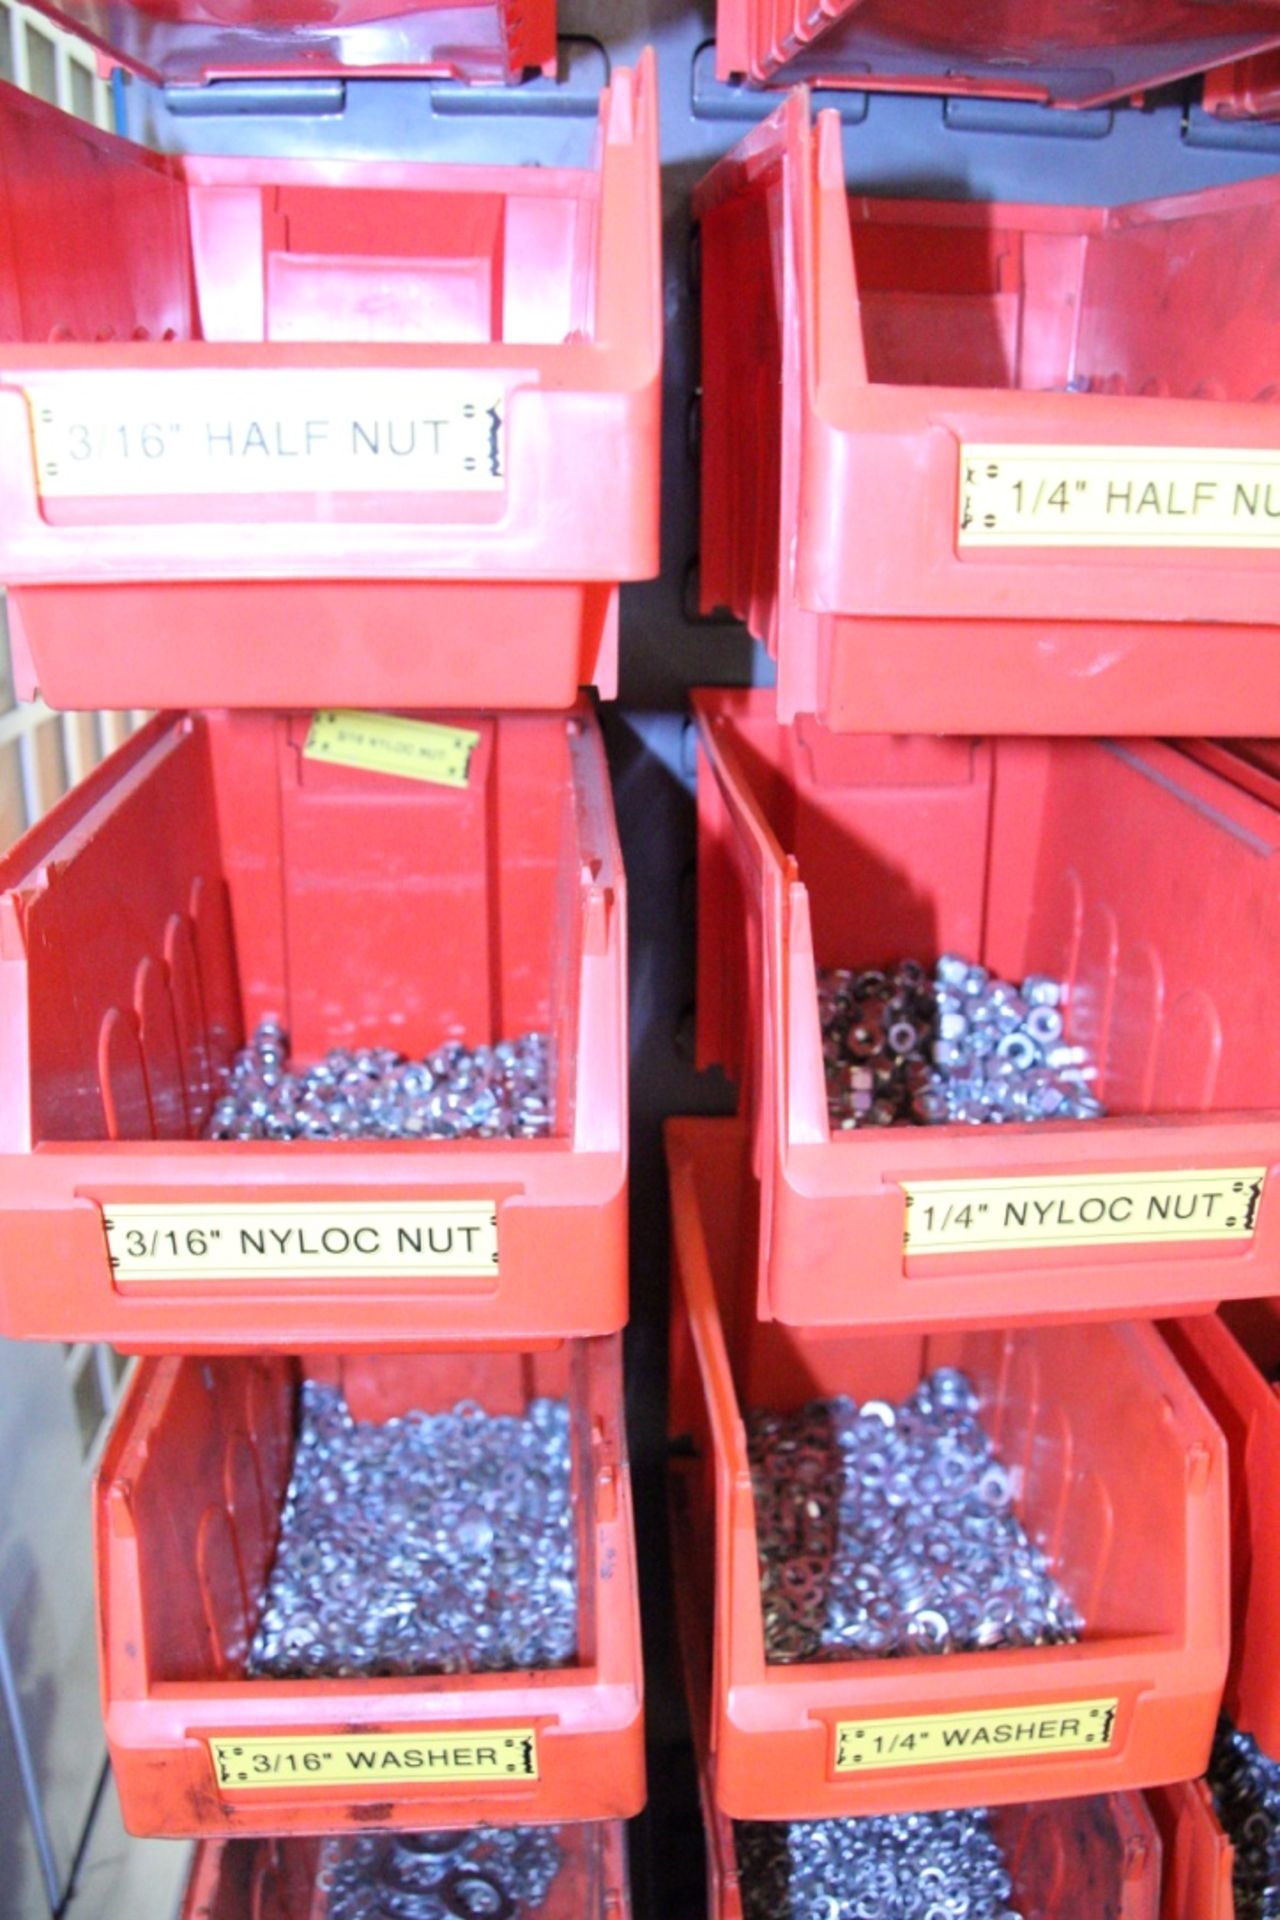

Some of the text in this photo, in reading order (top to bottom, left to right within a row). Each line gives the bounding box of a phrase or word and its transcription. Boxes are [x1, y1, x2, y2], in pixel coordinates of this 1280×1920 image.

[206, 421, 330, 457] HALF
[353, 421, 449, 456] NUT
[1011, 479, 1086, 514] 1/4"
[1106, 480, 1217, 515] HALF
[922, 1192, 1223, 1231] 1/4" NYLOC NUT
[125, 1226, 481, 1257] 3/16" NYLOC NUT
[873, 1718, 1081, 1754] 1/4" WASHER
[252, 1747, 498, 1773] 3/16" WASHER
